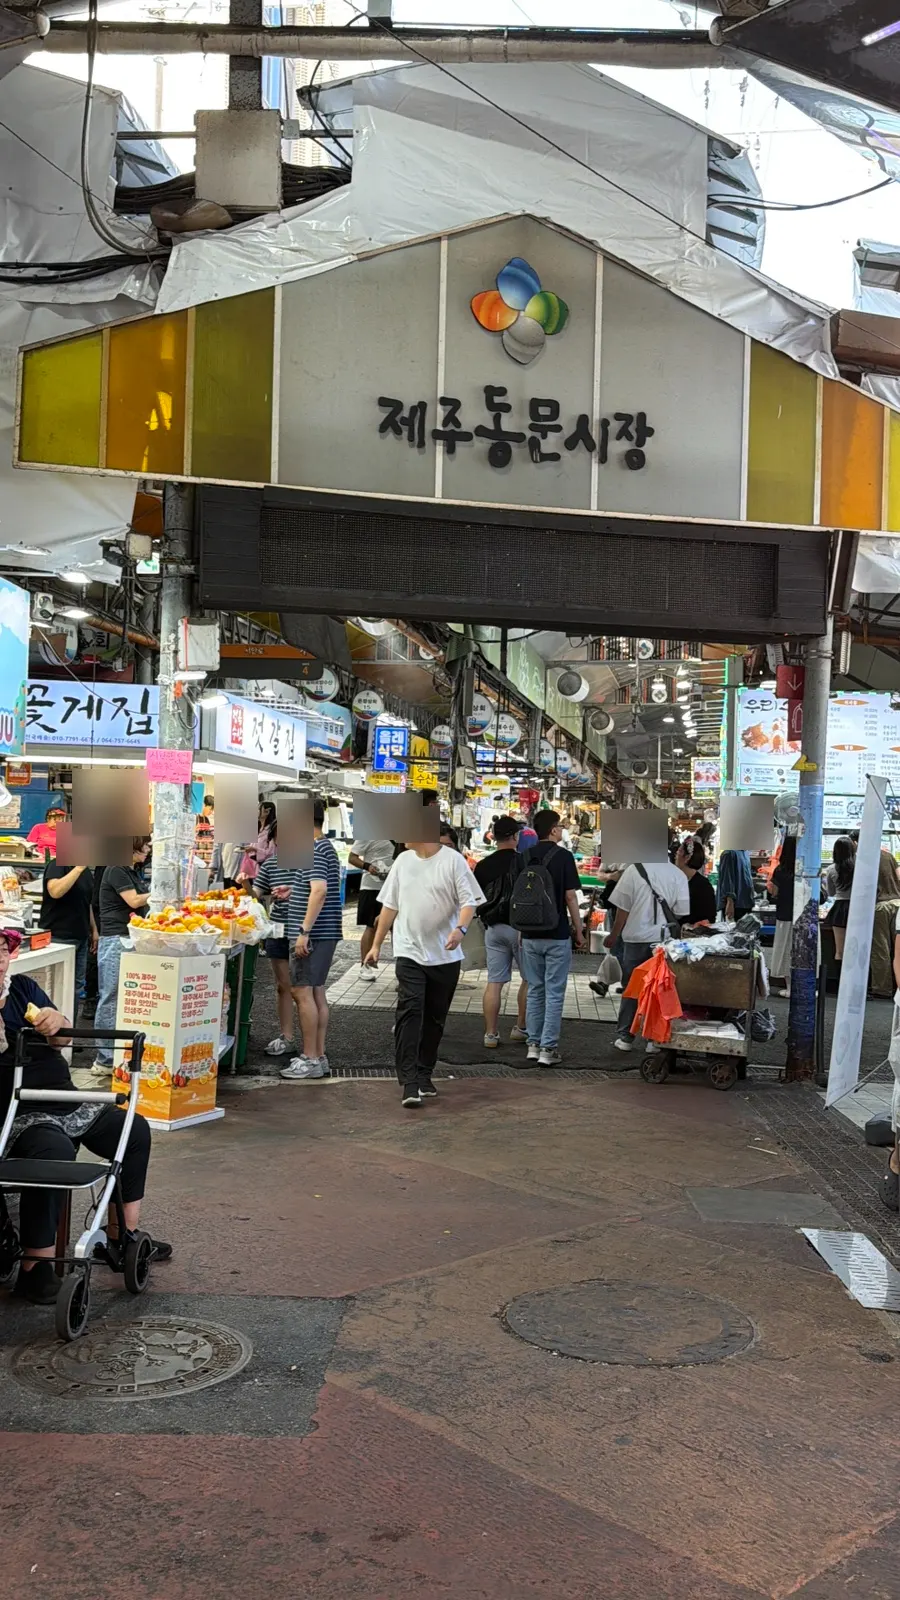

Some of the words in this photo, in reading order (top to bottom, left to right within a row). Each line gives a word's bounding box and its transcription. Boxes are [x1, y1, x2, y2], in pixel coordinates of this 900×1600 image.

[377, 384, 655, 471] 제주동문시장
[26, 683, 155, 737] 꽃게집
[379, 730, 405, 744] 올레
[378, 745, 404, 758] 식당
[416, 773, 435, 784] 수산
[126, 972, 141, 980] 100%
[124, 989, 150, 999] 제주에서
[151, 992, 171, 1001] 만나는
[182, 993, 203, 1001] 제주에서
[124, 997, 138, 1006] 정말
[123, 1005, 152, 1016] 인생주스!
